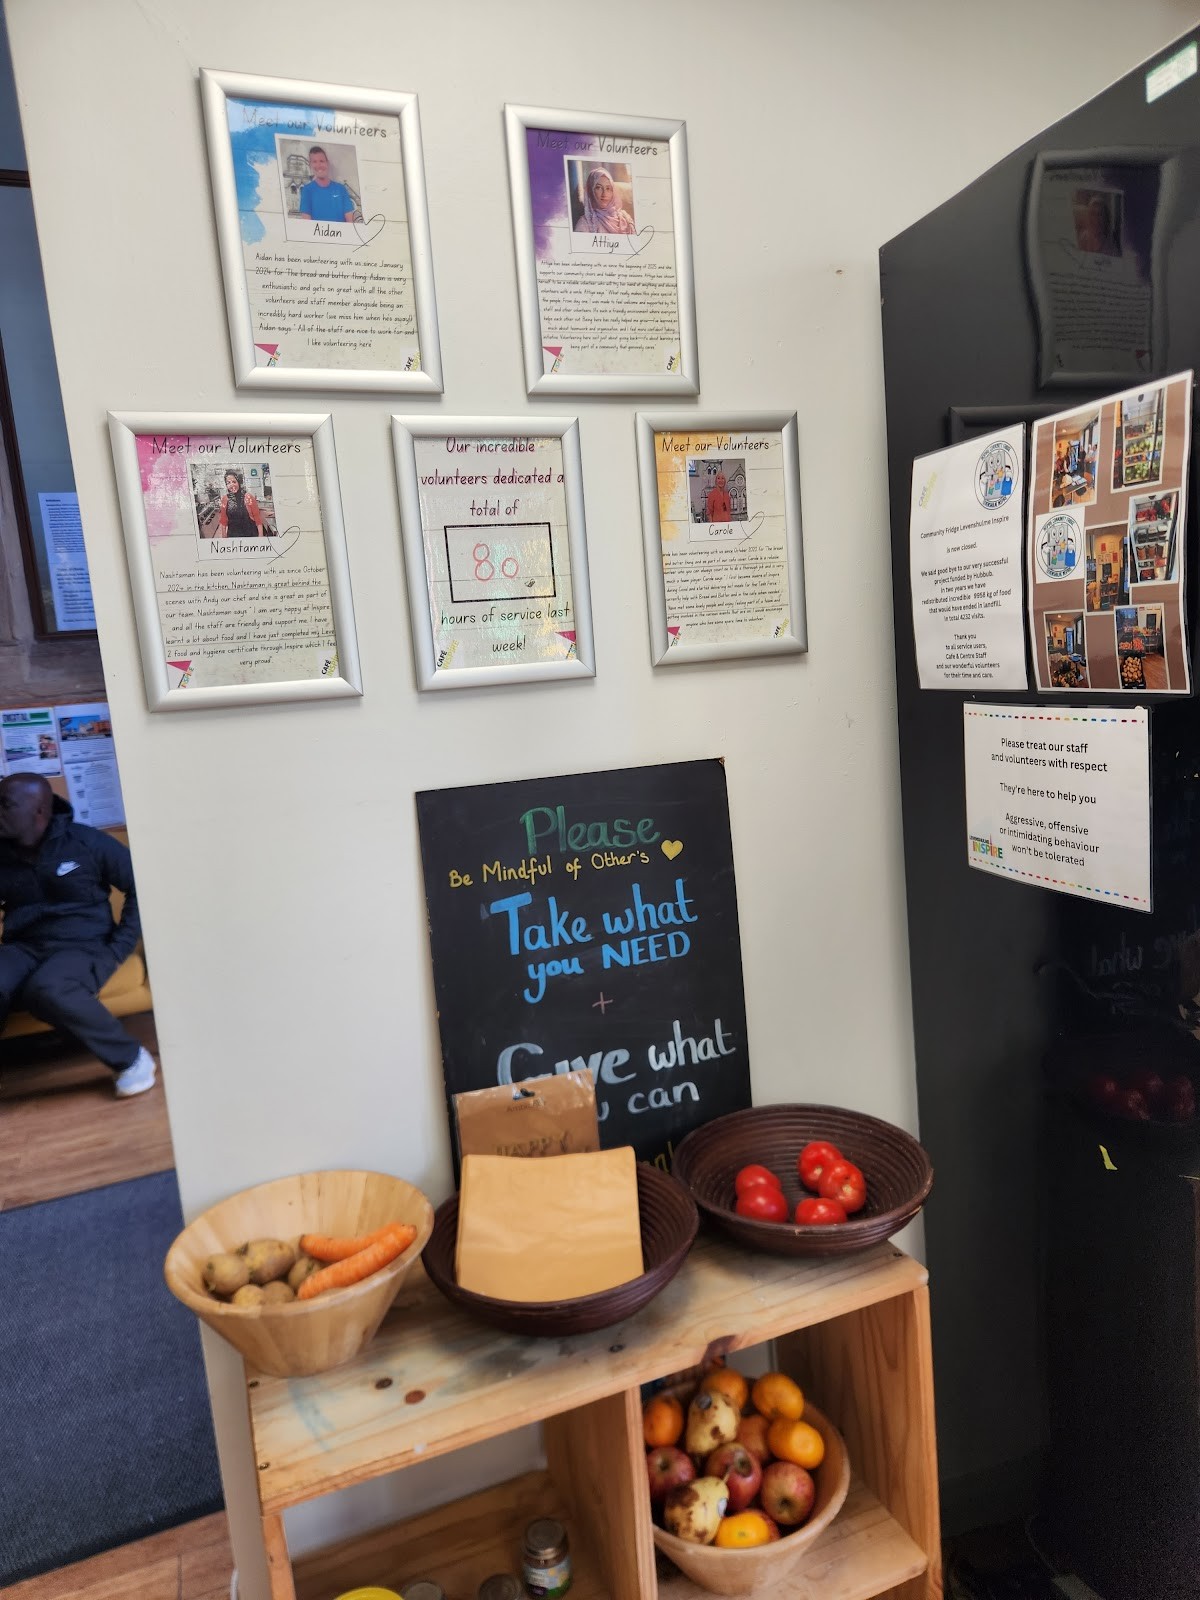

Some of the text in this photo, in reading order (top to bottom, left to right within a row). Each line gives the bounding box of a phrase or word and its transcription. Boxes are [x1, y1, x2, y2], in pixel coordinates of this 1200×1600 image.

[242, 108, 387, 138] Meet our Volunteers
[537, 131, 658, 156] Meet our Volunteers
[313, 223, 342, 237] Aidan
[592, 236, 620, 254] Attiya
[256, 253, 272, 261] Aidan
[275, 254, 285, 262] has
[288, 255, 301, 263] been
[304, 256, 338, 268] volunteering
[379, 261, 403, 271] January
[262, 282, 297, 291] enthusiastic
[313, 285, 325, 295] gets
[337, 285, 352, 295] great
[354, 286, 366, 294] with
[378, 287, 386, 295] the
[389, 287, 403, 295] other
[328, 299, 350, 307] member
[353, 300, 378, 310] alongside
[380, 301, 394, 311] being
[667, 356, 675, 371] CAFE
[152, 436, 301, 454] Meet our Volunteers
[446, 437, 535, 453] Our incredible
[662, 436, 769, 452] Meet our Volunteers
[421, 467, 565, 486] volunteers dedicated a
[470, 499, 520, 516] total of
[709, 524, 733, 536] Carole
[921, 515, 1009, 539] Community Fridge Levenshulme Inspire
[210, 541, 272, 554] Nashtaman
[961, 542, 977, 551] closed.
[160, 571, 195, 580] Nashtaman
[198, 569, 208, 578] has
[211, 568, 225, 577] been
[227, 567, 262, 579] volunteering
[264, 567, 277, 576] with
[938, 568, 948, 576] good
[949, 566, 957, 574] bye
[983, 558, 1009, 568] successful
[934, 577, 950, 585] project
[974, 571, 994, 579] Hubbub.
[188, 597, 202, 605] with
[204, 596, 219, 606] Andy
[233, 593, 246, 602] chef
[249, 592, 260, 601] and
[262, 592, 271, 600] she
[280, 593, 296, 603] great
[306, 591, 319, 601] part
[321, 590, 328, 598] of
[441, 602, 570, 625] hours of service last
[172, 624, 183, 632] and
[195, 622, 205, 630] the
[207, 621, 224, 629] staff
[237, 619, 260, 630] friendly
[263, 617, 273, 626] and
[275, 618, 297, 628] support
[492, 635, 526, 653] week!
[322, 659, 332, 675] CAFE
[437, 649, 447, 668] CAFE
[1001, 738, 1089, 753] Please treat our staff
[992, 753, 1108, 773] and volunteers with respect
[1000, 782, 1097, 805] They're here to help you
[519, 805, 661, 856] Please
[1005, 812, 1089, 836] Aggressive, offensive
[1008, 828, 1053, 847] intimidating
[1055, 837, 1099, 853] behaviour
[973, 841, 1003, 859] INSPIRE
[1012, 844, 1085, 867] won't be tolerated
[449, 850, 650, 889] Be Mindful of Other's
[490, 878, 698, 956] Take what
[523, 931, 691, 1004] you NEED
[648, 1018, 736, 1070] what
[628, 1081, 700, 1115] can
